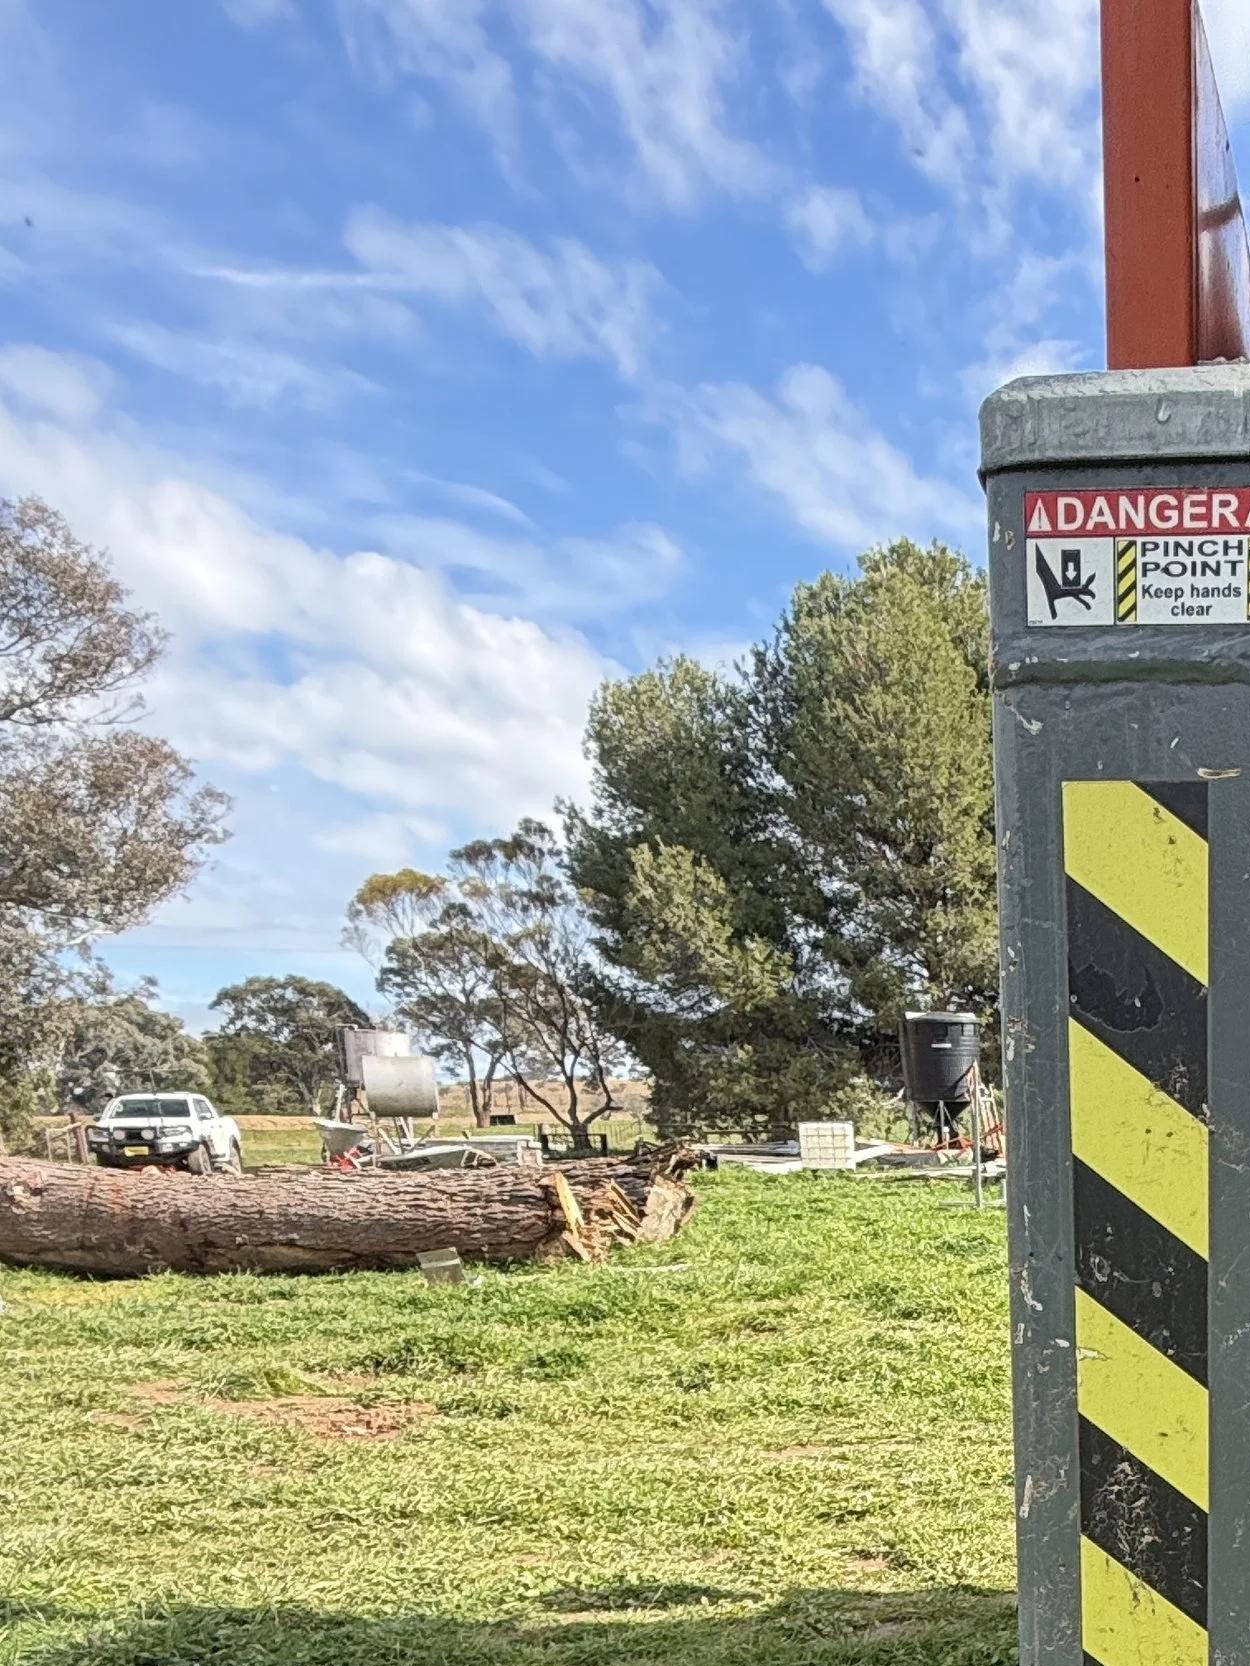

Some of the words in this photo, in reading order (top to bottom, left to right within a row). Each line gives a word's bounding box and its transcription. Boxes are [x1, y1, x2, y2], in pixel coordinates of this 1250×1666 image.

[1057, 494, 1241, 531] DANGER
[1141, 539, 1244, 558] PINCH
[1141, 560, 1244, 578] POINT
[1141, 583, 1184, 600] Keep
[1190, 582, 1242, 598] hands
[1170, 602, 1213, 617] clear
